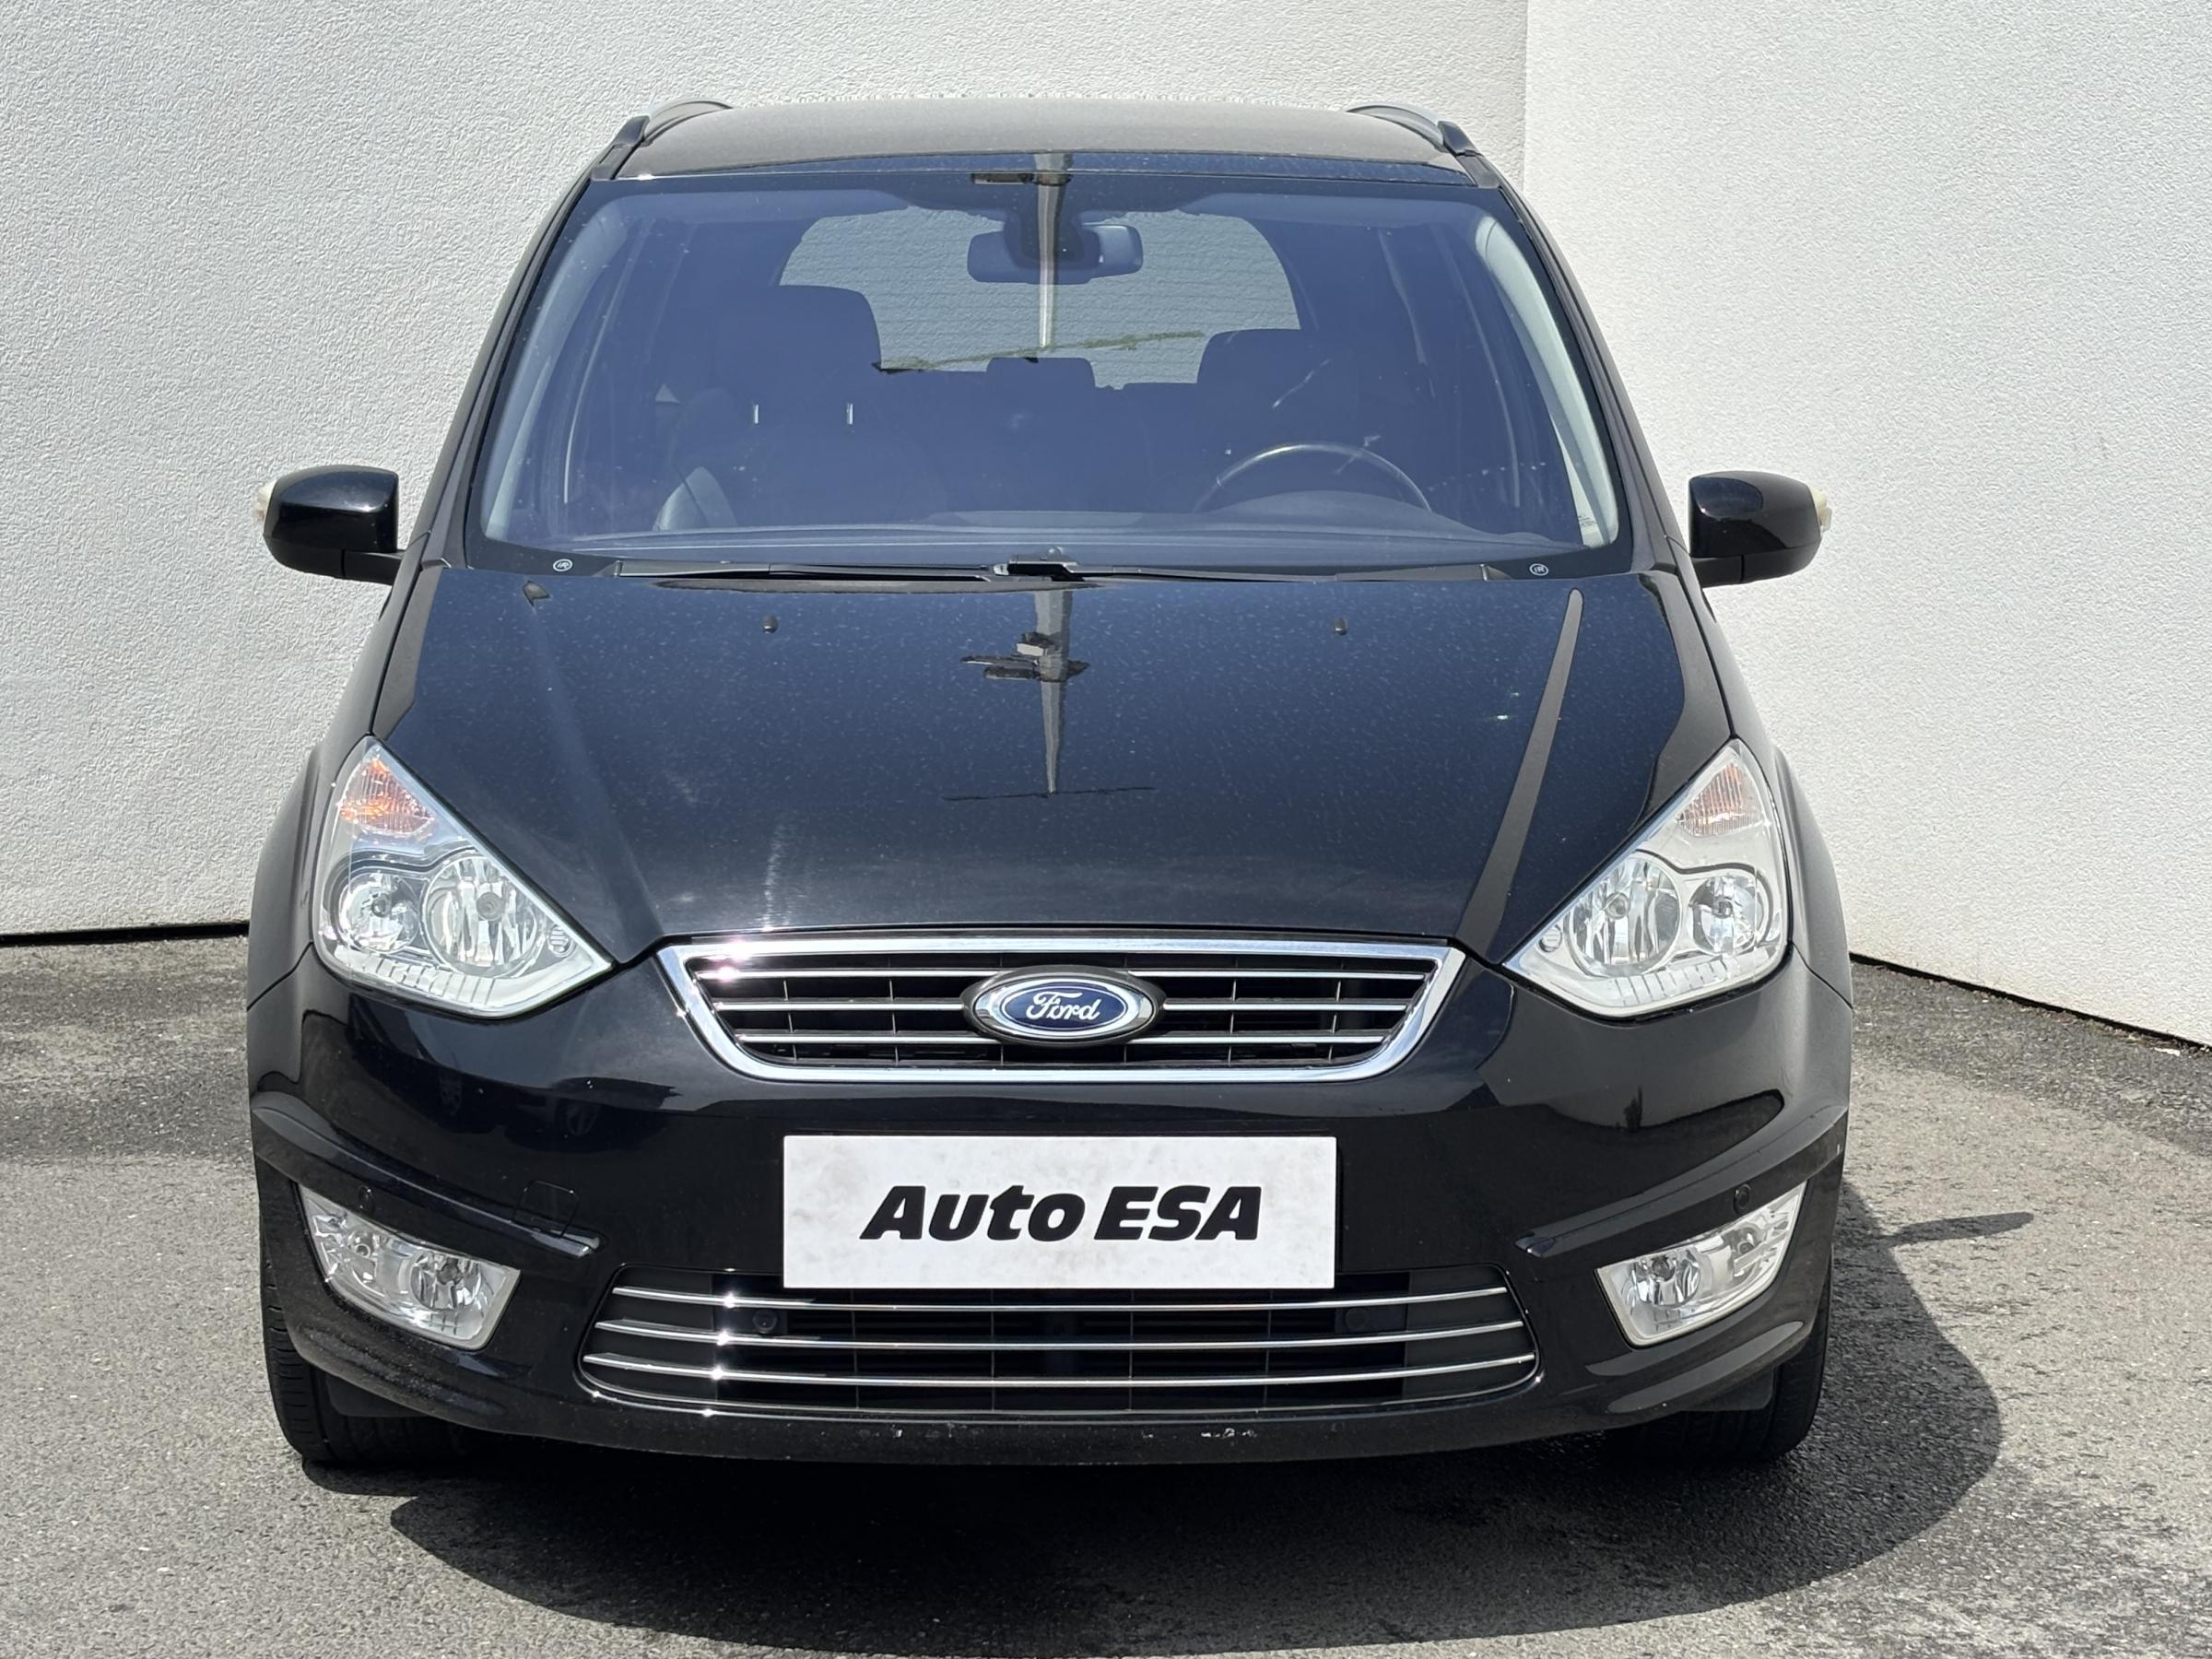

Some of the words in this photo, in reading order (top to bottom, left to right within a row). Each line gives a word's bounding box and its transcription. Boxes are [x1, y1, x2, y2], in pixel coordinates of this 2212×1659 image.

[1026, 991, 1101, 1021] Ford
[859, 1185, 1086, 1241] Auto
[1093, 1185, 1262, 1241] ESA
